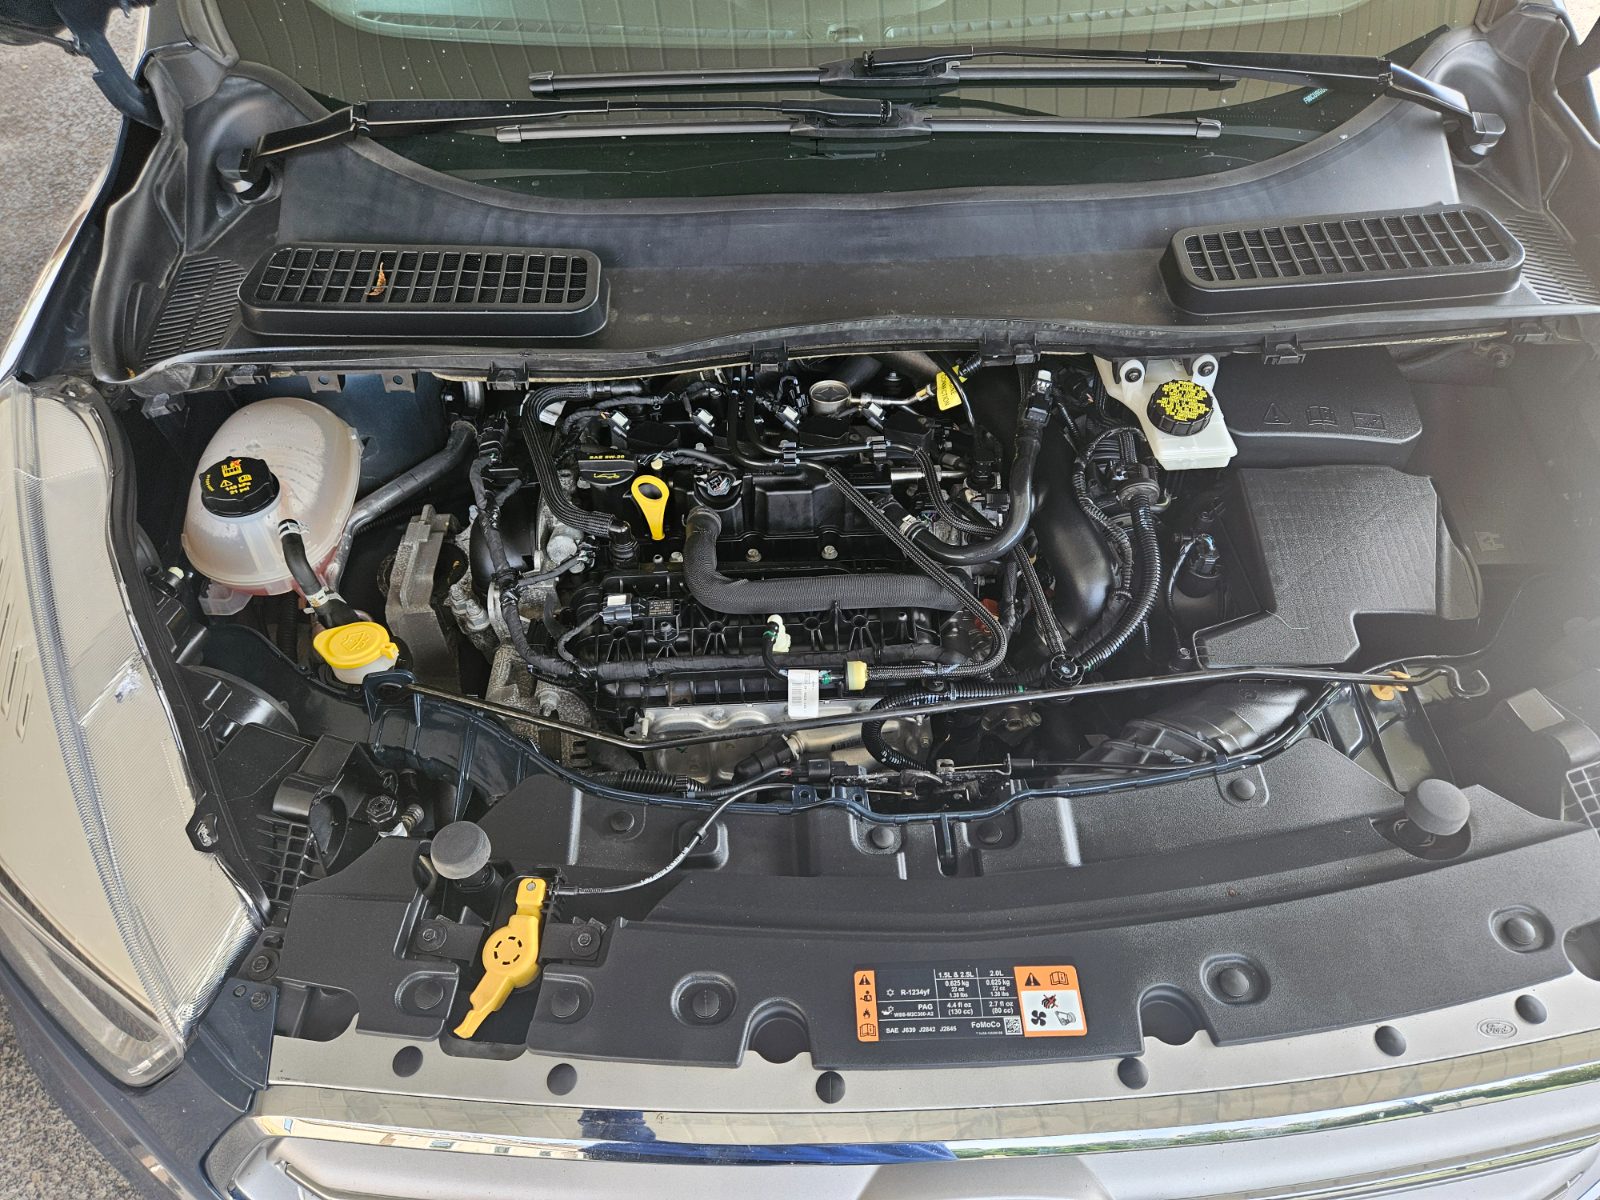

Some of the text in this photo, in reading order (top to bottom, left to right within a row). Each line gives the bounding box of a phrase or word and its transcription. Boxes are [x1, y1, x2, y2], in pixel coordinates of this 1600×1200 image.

[961, 980, 970, 988] kg
[1002, 979, 1011, 987] kg
[900, 988, 931, 997] R-1234yf
[948, 1008, 974, 1016] (130 cc)
[992, 1007, 1014, 1015] (80 cc)
[971, 1021, 1001, 1029] FoMoCo
[1485, 1023, 1507, 1034] Ford
